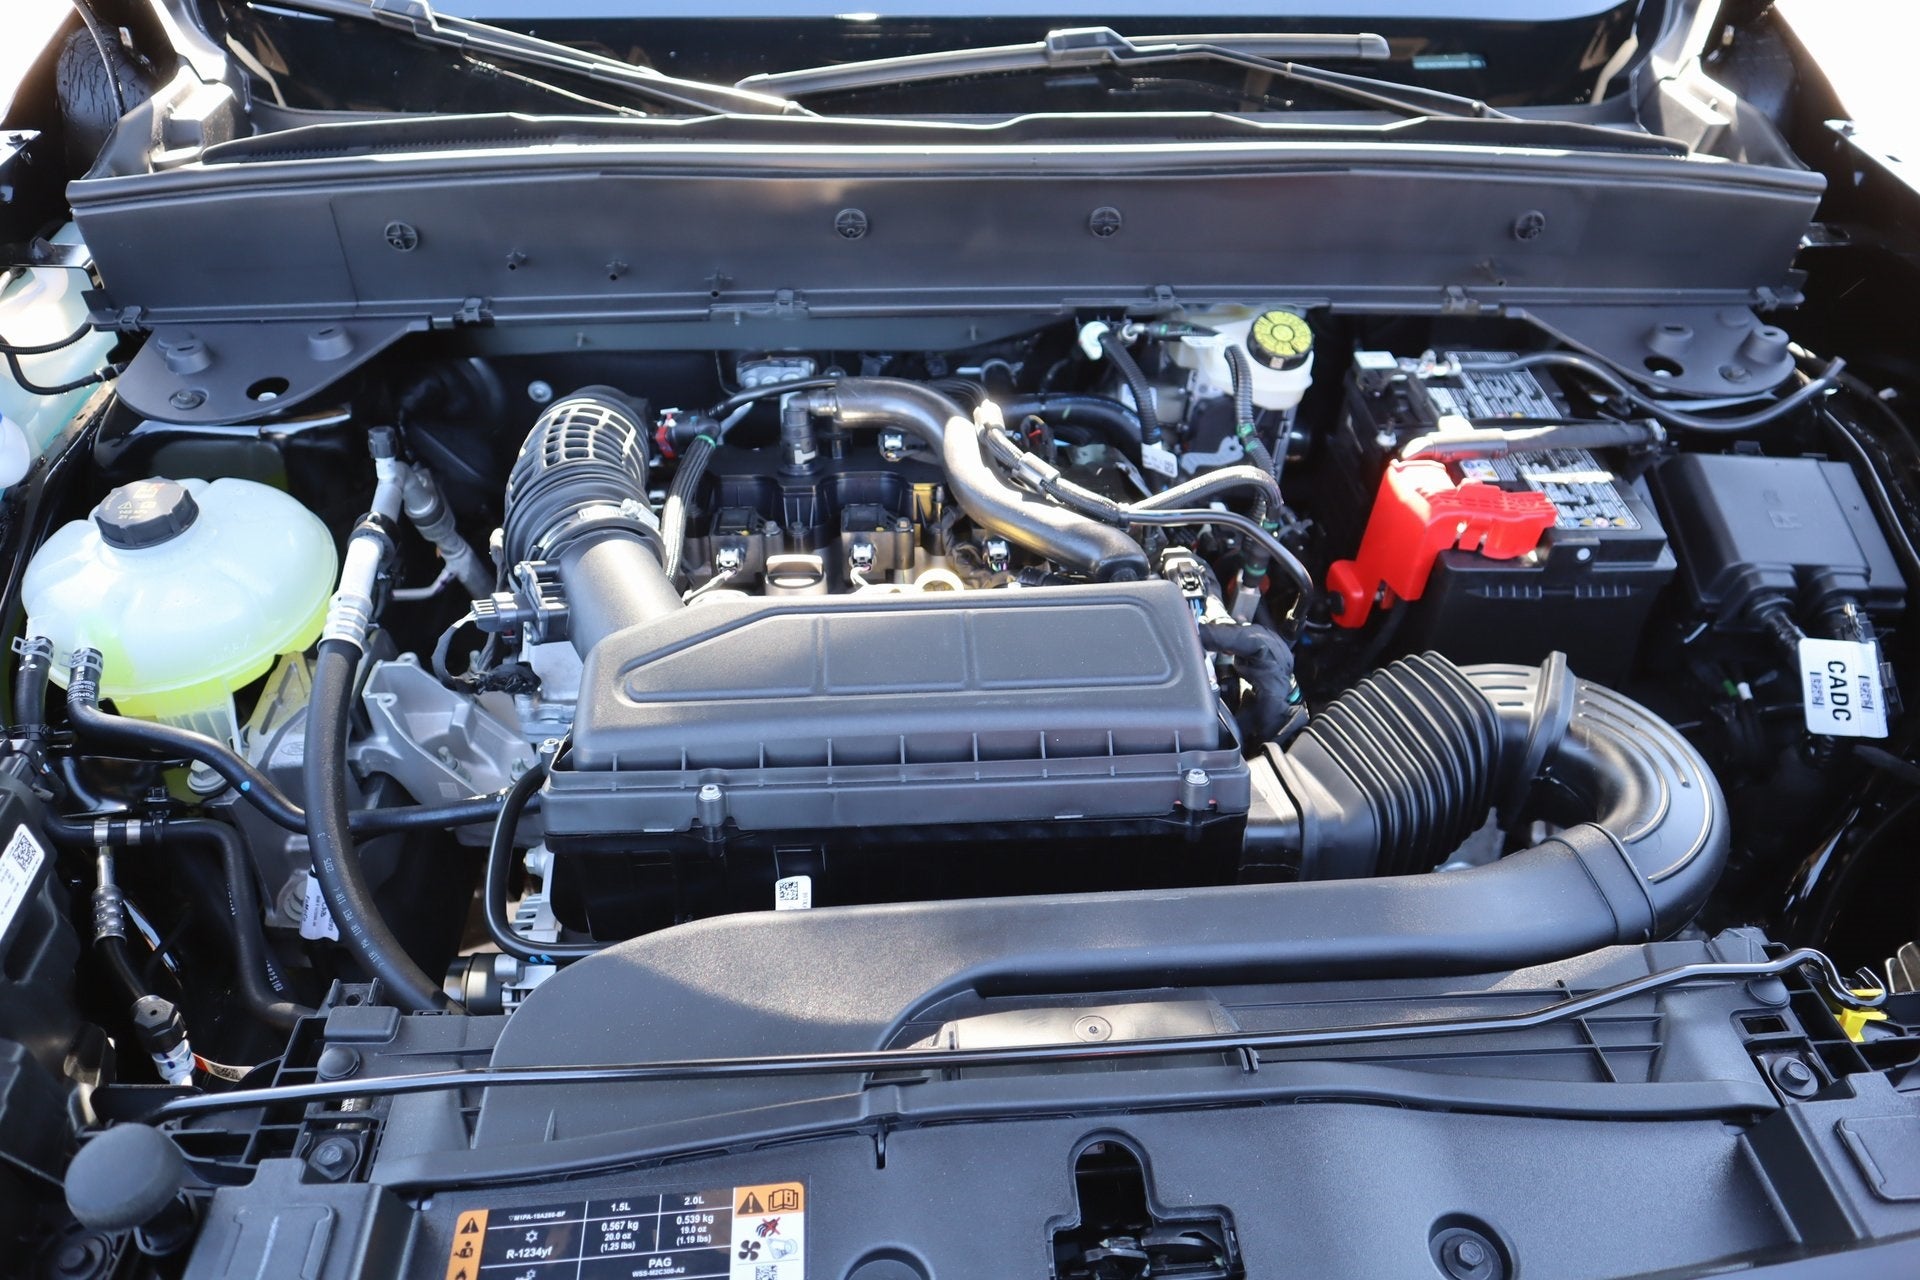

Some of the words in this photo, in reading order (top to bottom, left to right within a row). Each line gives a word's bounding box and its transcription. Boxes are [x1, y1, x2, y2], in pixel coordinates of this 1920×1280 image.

[1827, 660, 1852, 722] CADC
[684, 1196, 705, 1206] 2.0L
[611, 1202, 631, 1212] 1.5L
[676, 1215, 700, 1225] 0.539
[702, 1214, 714, 1225] kg
[601, 1221, 625, 1232] 0.567
[627, 1220, 639, 1232] kg
[680, 1226, 696, 1235] 19.0
[697, 1225, 707, 1234] oz
[604, 1232, 621, 1241] 20.0
[622, 1232, 632, 1240] oz
[676, 1236, 695, 1246] (1.19
[696, 1234, 712, 1244] lbs)
[506, 1246, 553, 1259] R-1234yf
[600, 1242, 619, 1253] (1.25
[620, 1241, 636, 1251] lbs)
[648, 1257, 672, 1268] PAG
